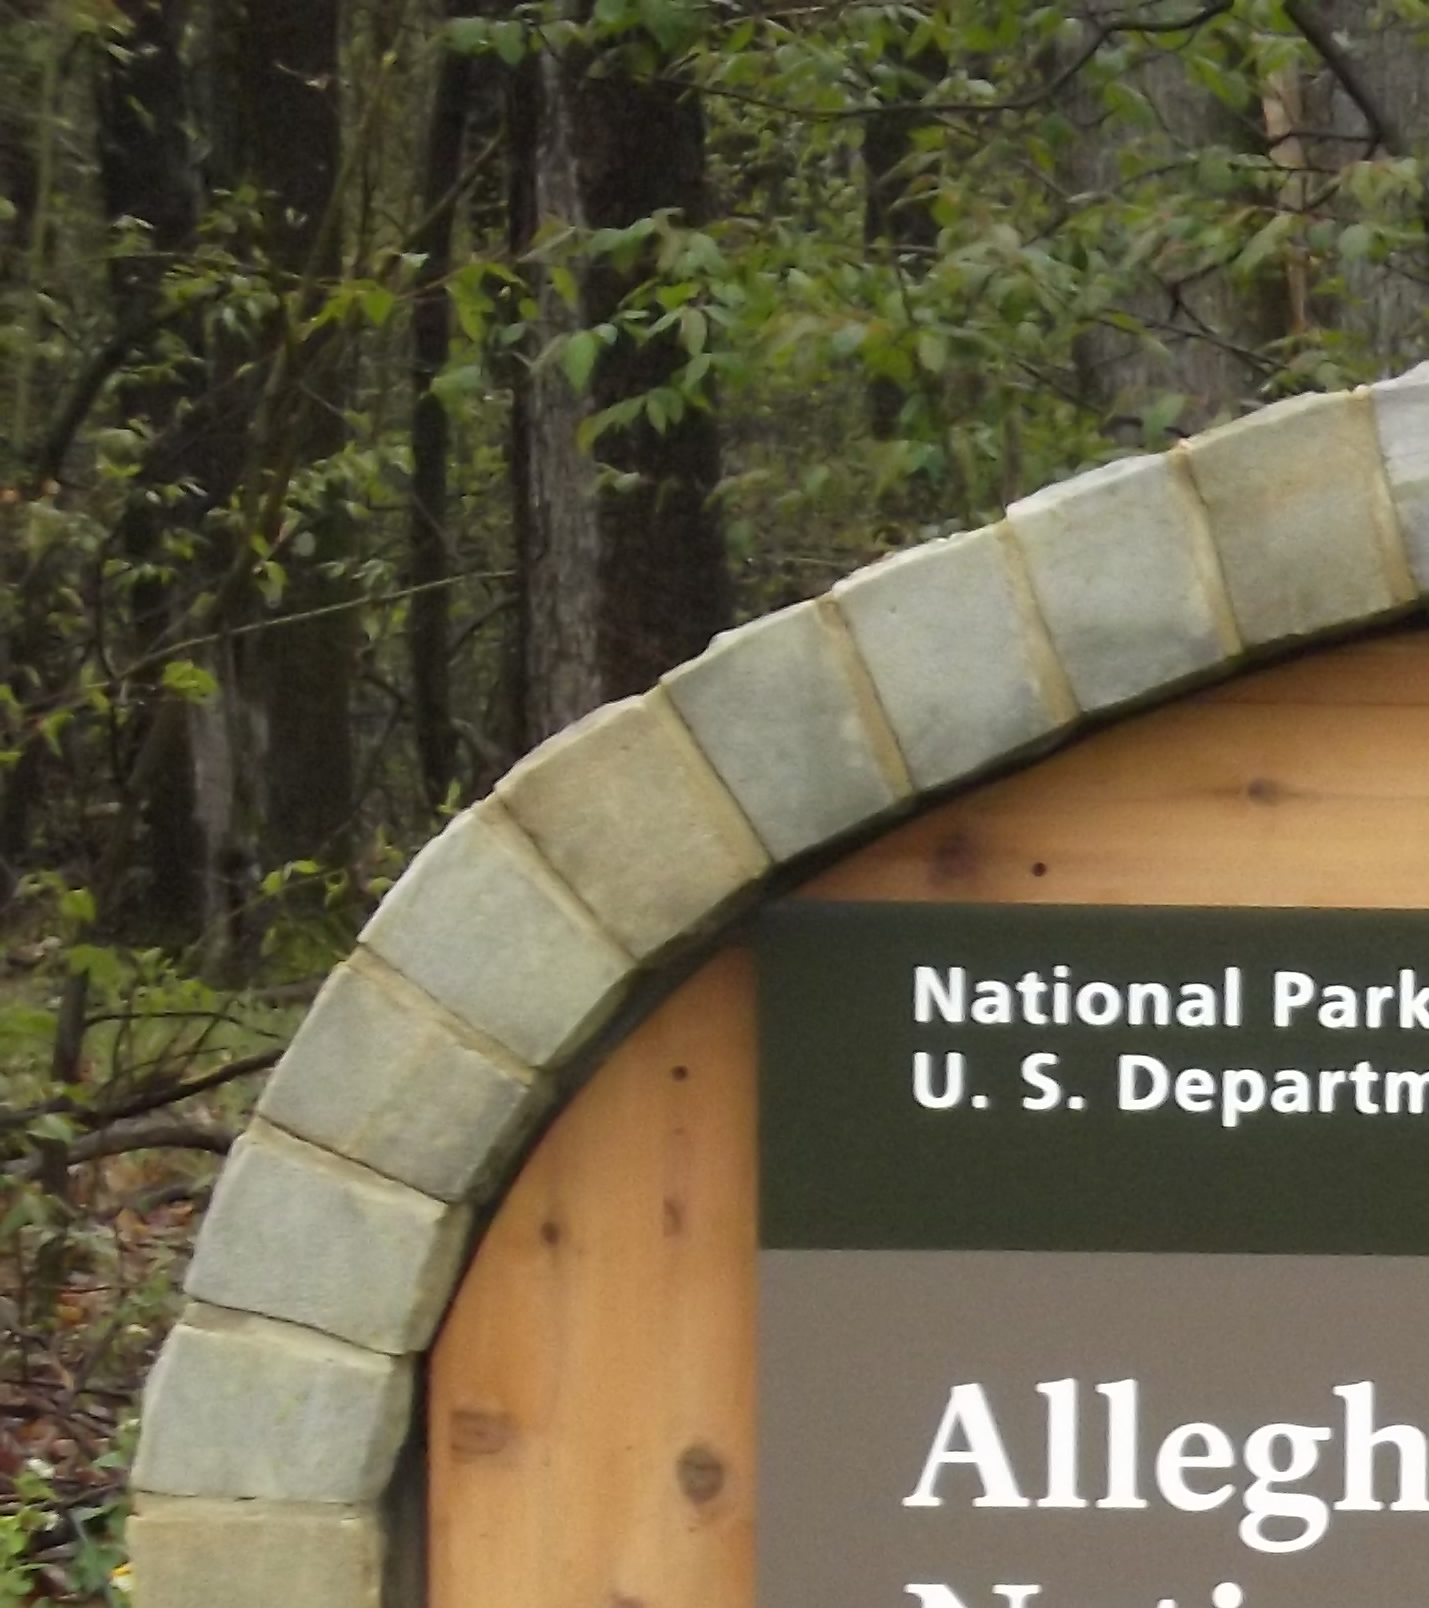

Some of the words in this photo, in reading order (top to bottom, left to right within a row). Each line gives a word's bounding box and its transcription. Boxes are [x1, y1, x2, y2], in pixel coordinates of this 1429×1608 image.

[914, 965, 1241, 1028] National
[913, 1051, 989, 1109] U.
[1021, 1052, 1085, 1111] S.
